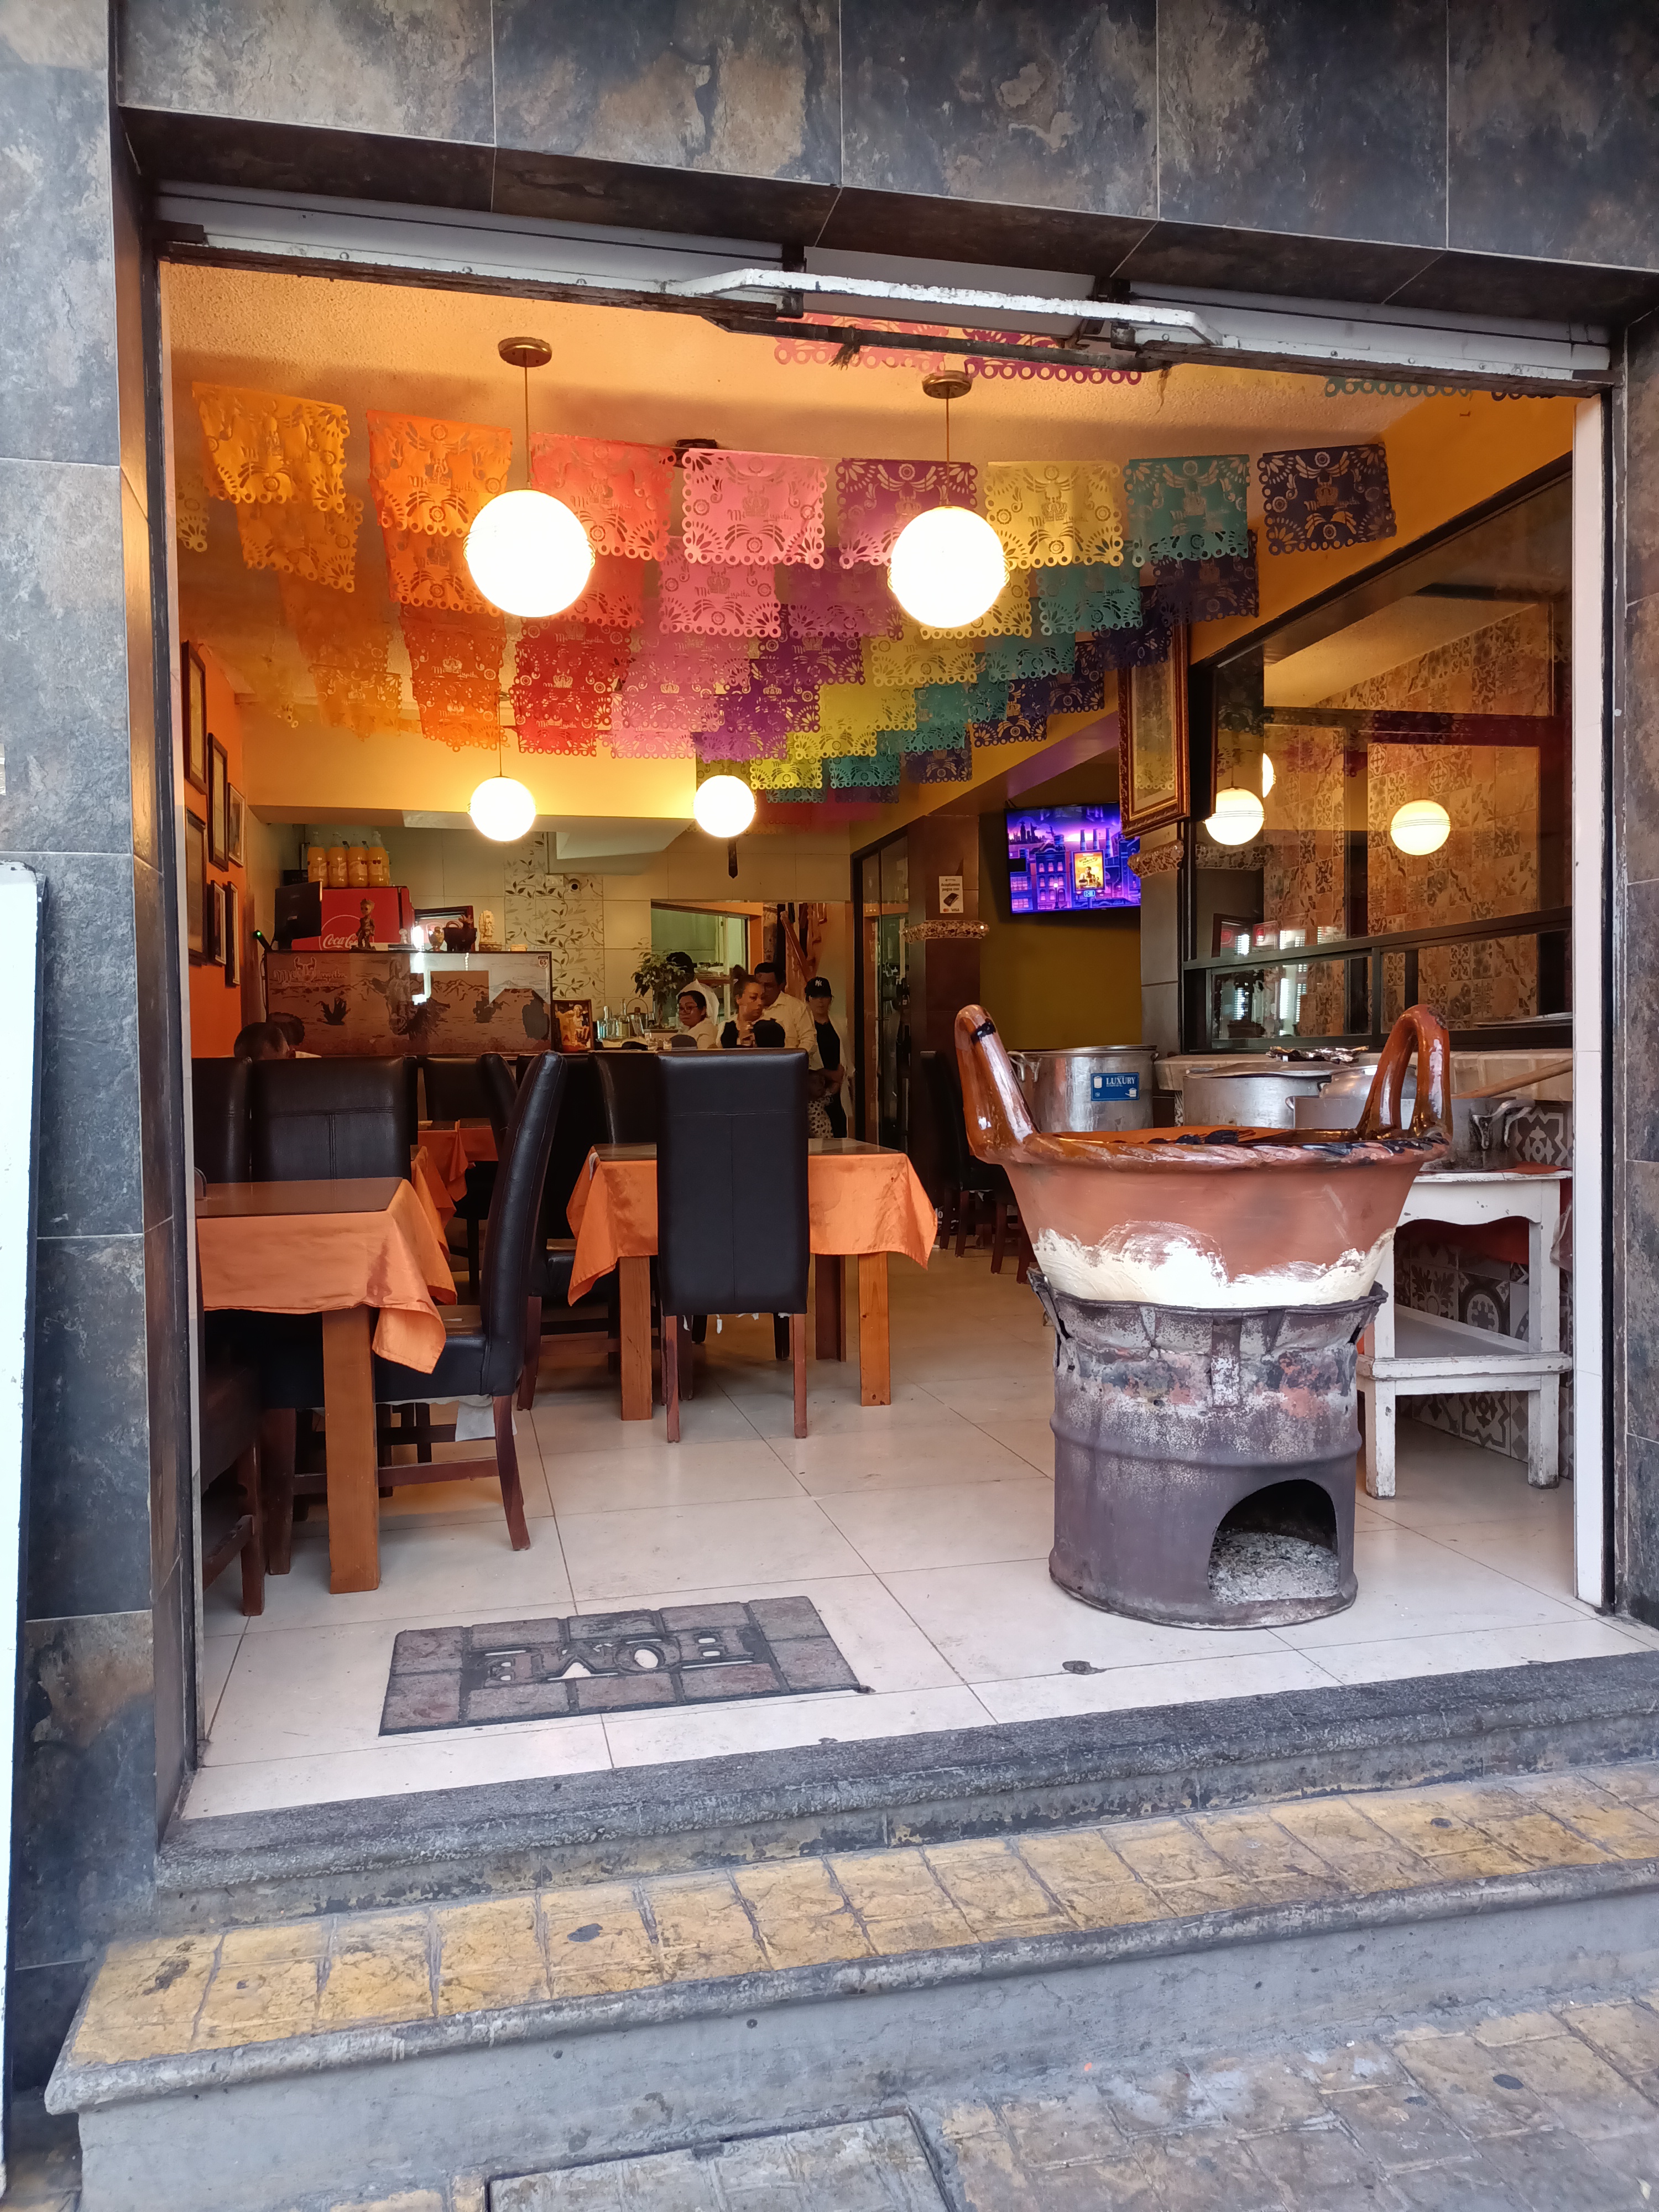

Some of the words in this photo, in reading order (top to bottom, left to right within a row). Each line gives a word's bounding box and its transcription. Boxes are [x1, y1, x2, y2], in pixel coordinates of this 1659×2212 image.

[727, 509, 747, 521] Mi
[694, 586, 711, 597] Mi
[792, 644, 806, 654] Mi
[1105, 1077, 1136, 1085] LUXURY
